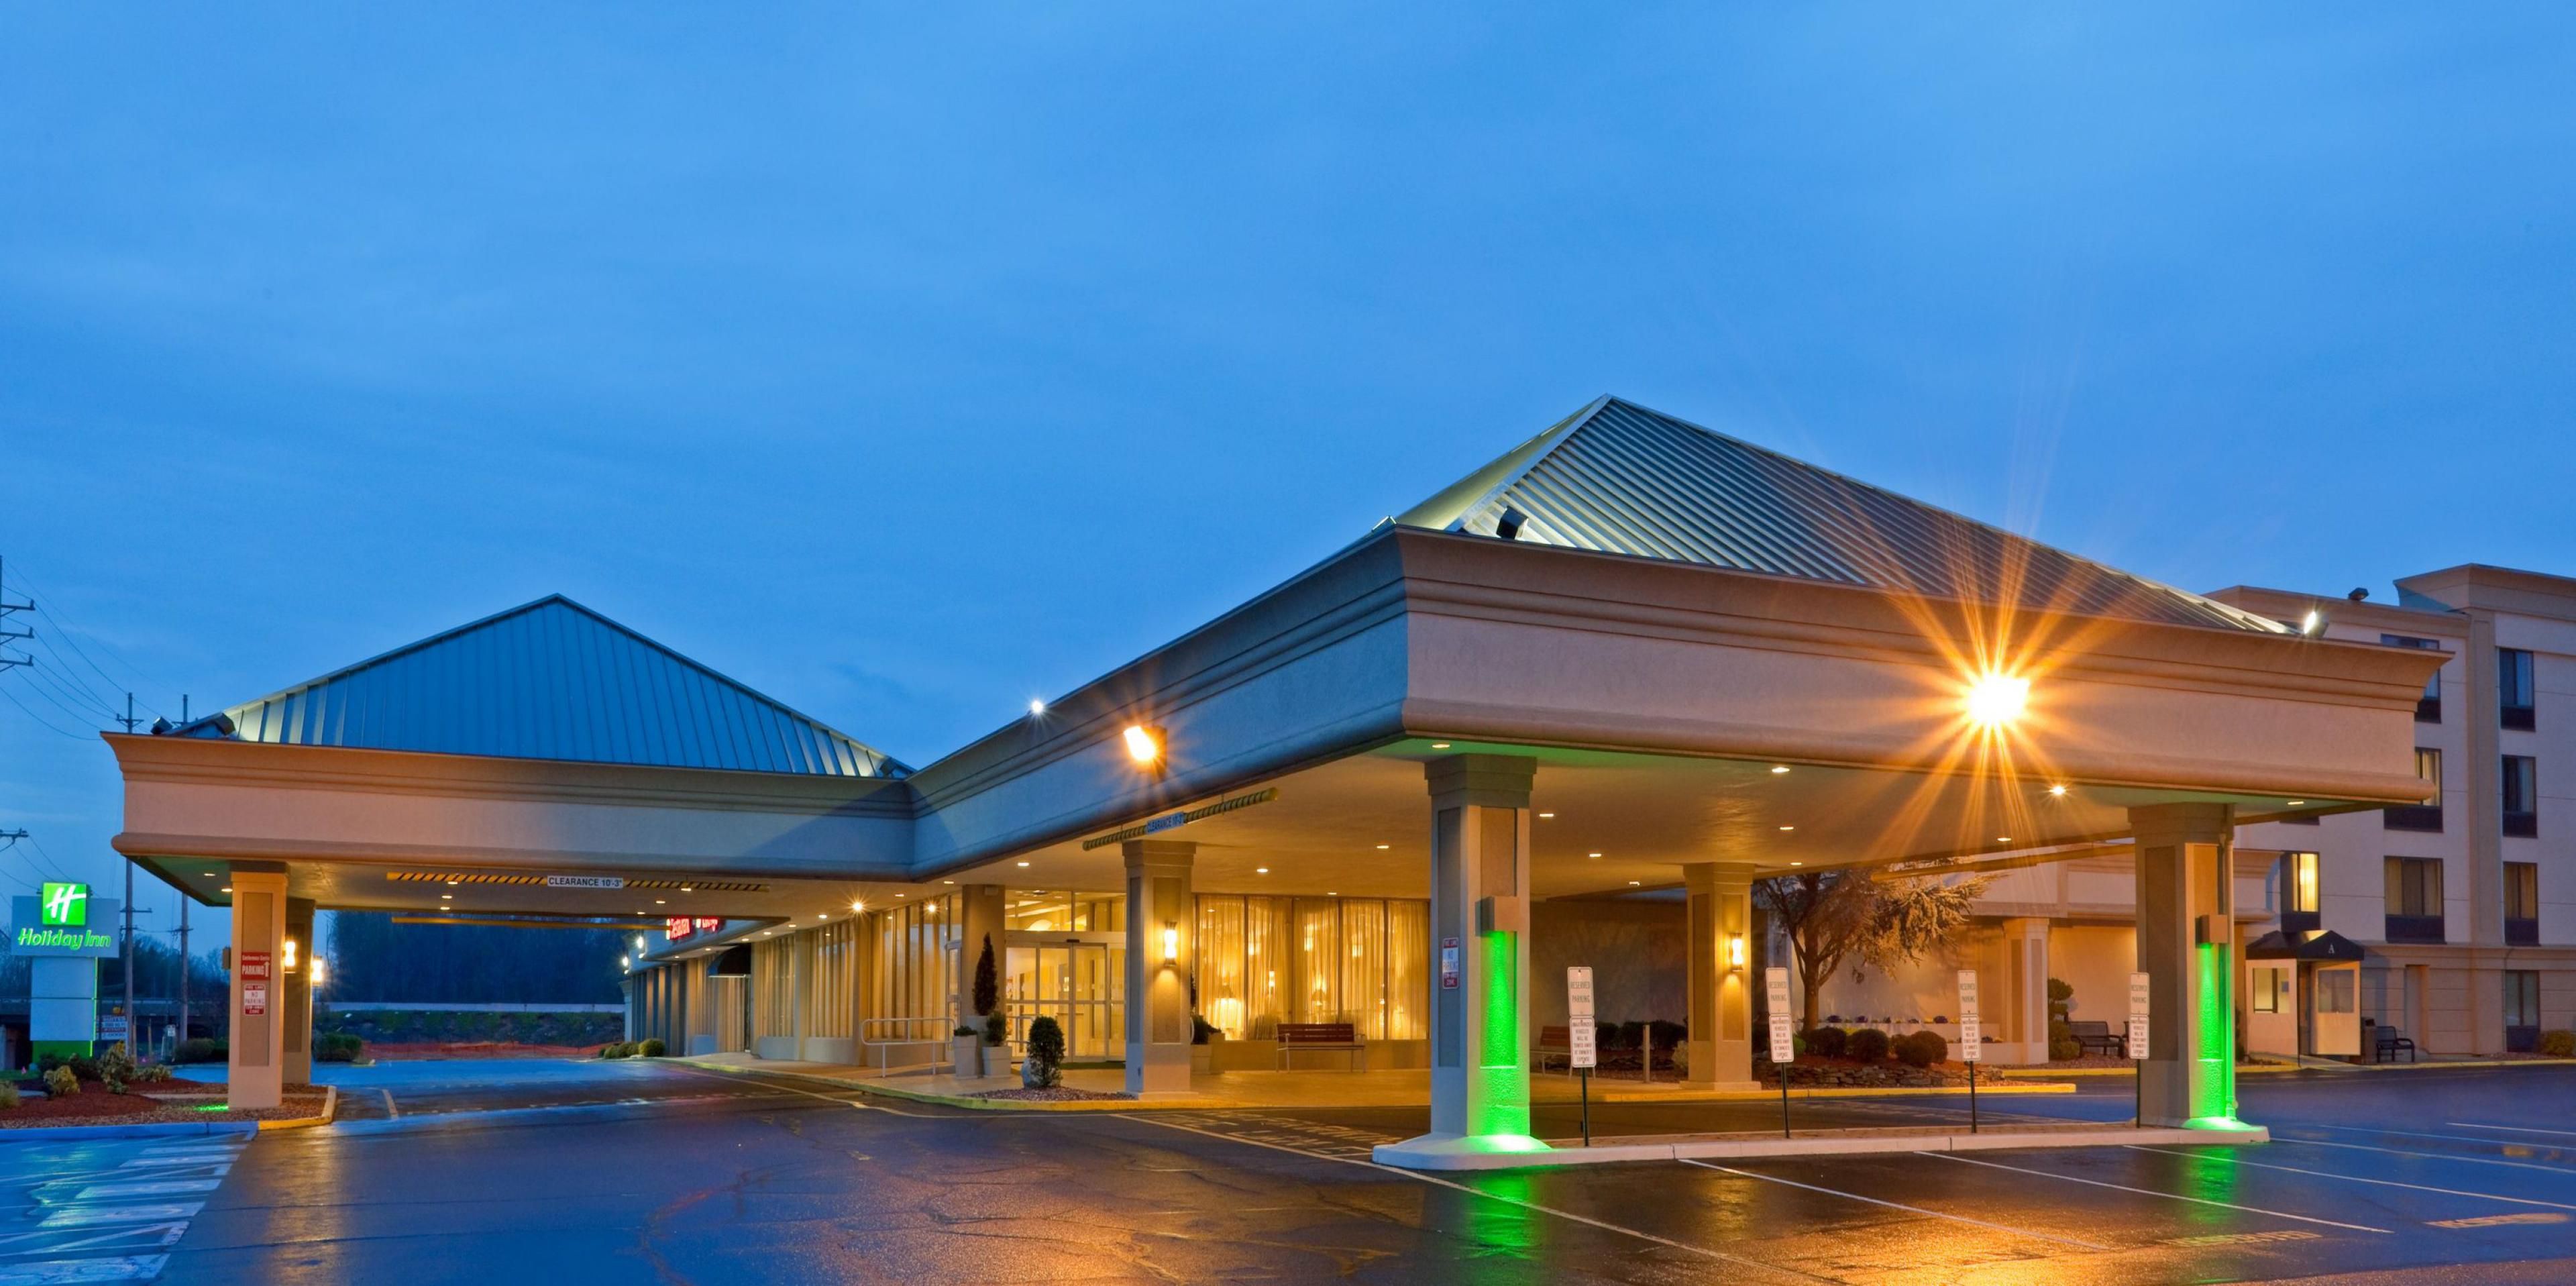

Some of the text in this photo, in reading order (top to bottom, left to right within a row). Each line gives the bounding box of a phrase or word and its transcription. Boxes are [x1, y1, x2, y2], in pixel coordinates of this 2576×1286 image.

[548, 877, 599, 886] CLEARANCE
[17, 927, 111, 951] Holiday Inn
[2328, 943, 2334, 954] A
[242, 965, 264, 975] PARKING
[1572, 994, 1591, 1003] PARKING
